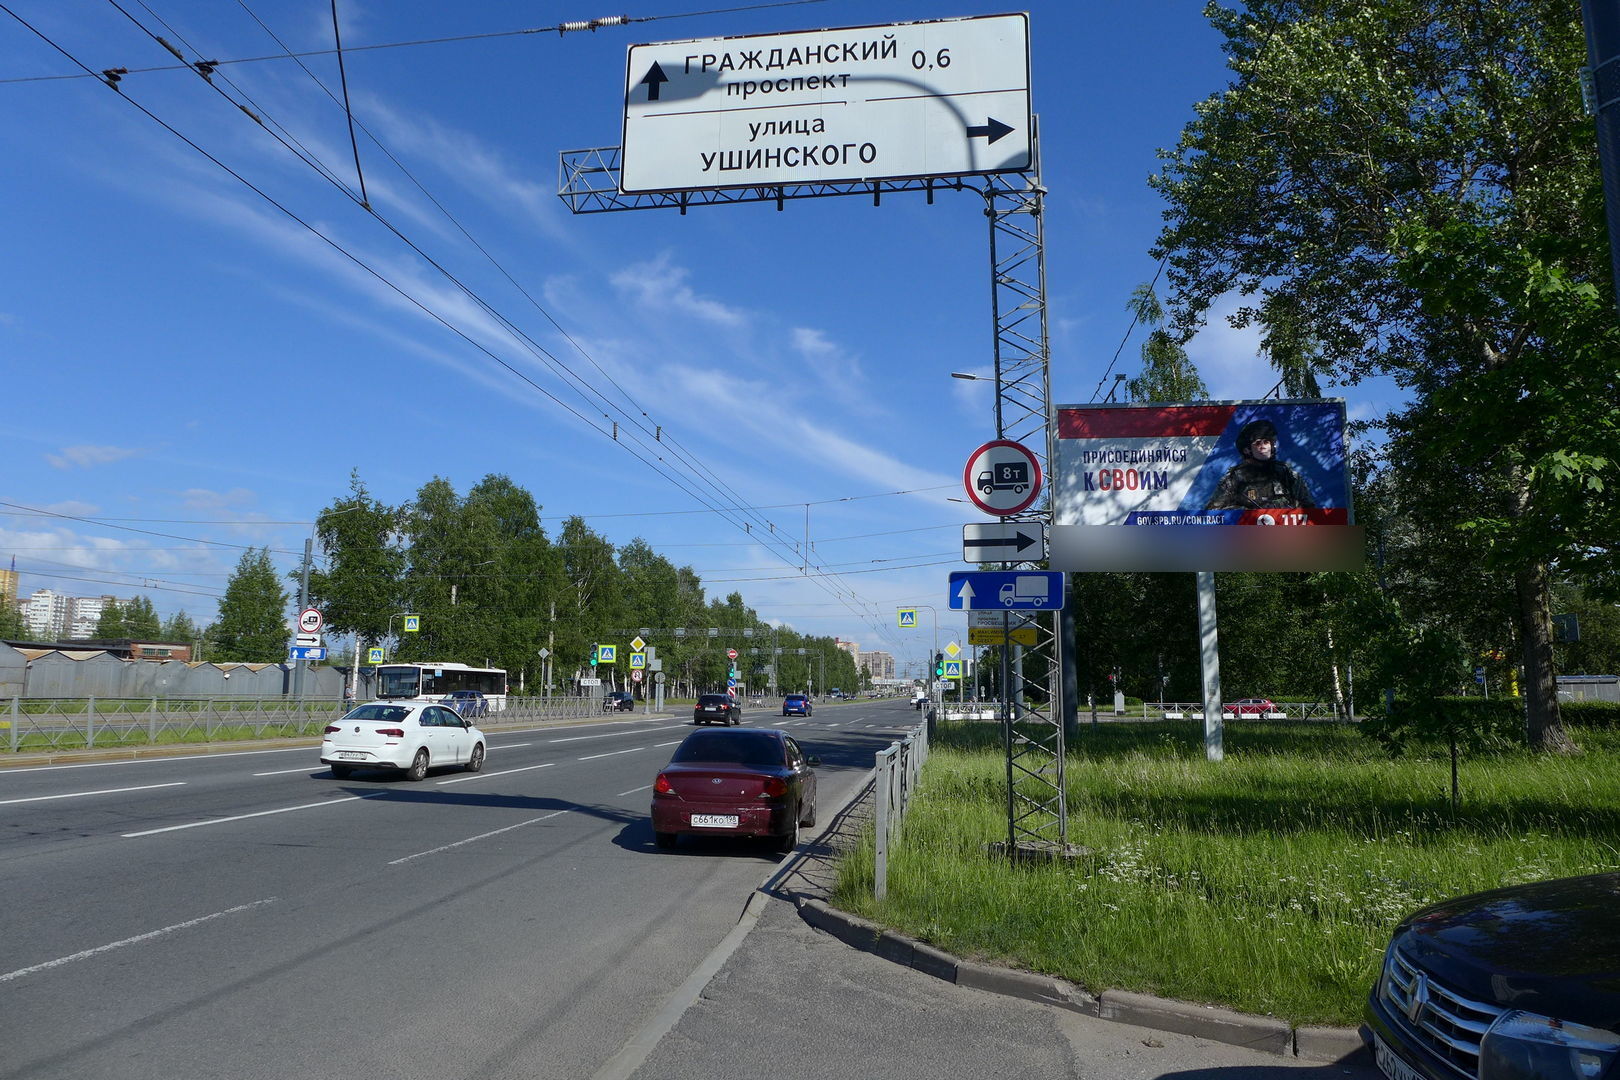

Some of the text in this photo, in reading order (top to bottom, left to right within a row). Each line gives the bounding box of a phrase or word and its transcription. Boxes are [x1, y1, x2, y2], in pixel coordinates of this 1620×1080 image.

[684, 34, 951, 74] ГРАЖДАНСКИЙ 0,6
[727, 73, 851, 100] проспект
[748, 118, 825, 141] улица
[700, 142, 877, 172] УШИНСКОГО
[1083, 446, 1187, 464] ПРИСОЕДИНЯЙСЯ
[1084, 468, 1168, 491] К СВОИМ
[1137, 514, 1224, 525] GOV.SPB.RU/CONTRACT
[1282, 514, 1308, 525] 117
